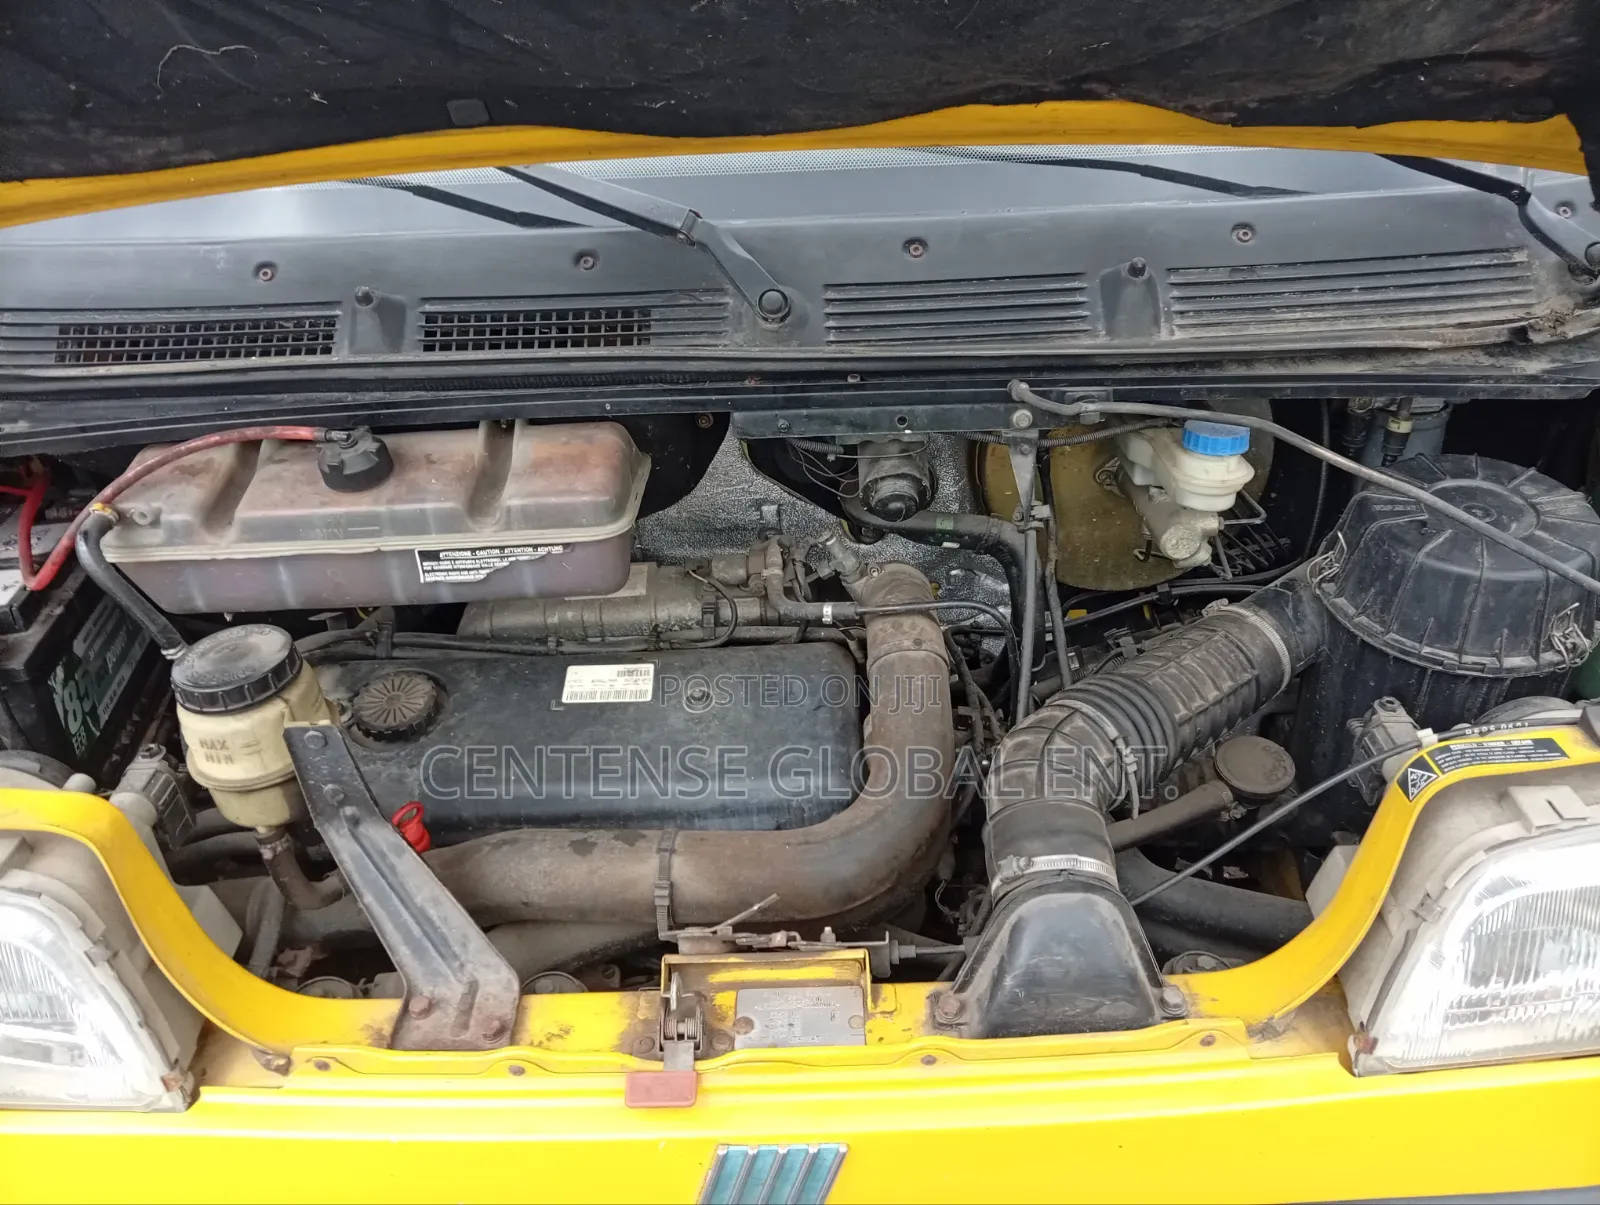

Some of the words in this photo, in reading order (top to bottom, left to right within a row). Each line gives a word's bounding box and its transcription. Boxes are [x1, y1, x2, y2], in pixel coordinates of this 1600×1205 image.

[440, 550, 471, 558] ATTENZIONE
[476, 548, 499, 557] CAUTION
[537, 545, 563, 553] ACHTUNG
[199, 738, 229, 751] MAX
[204, 750, 234, 764] MIN
